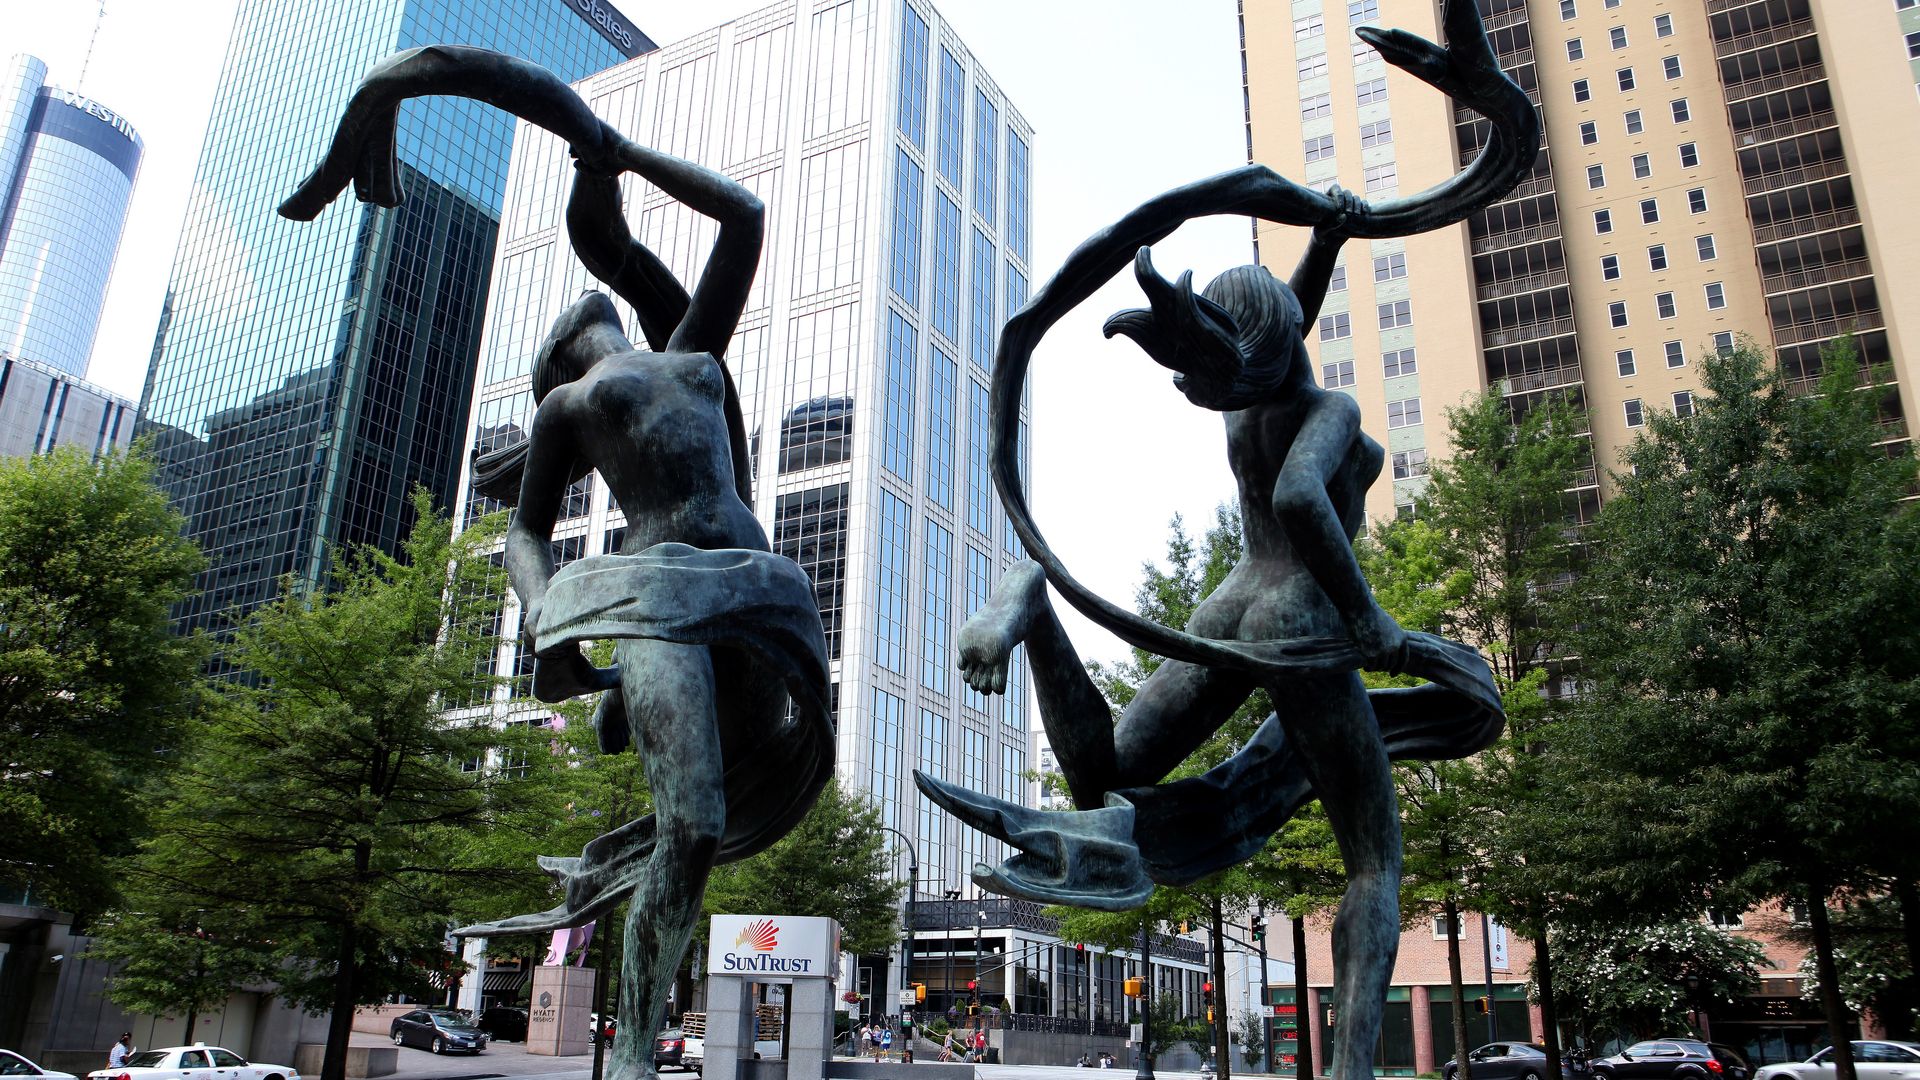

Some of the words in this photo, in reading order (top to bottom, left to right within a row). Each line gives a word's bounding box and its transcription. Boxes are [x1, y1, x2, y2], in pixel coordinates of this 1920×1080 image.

[64, 90, 136, 142] WESTIN
[723, 952, 812, 972] SUNTRUST
[533, 1009, 556, 1017] HYATT
